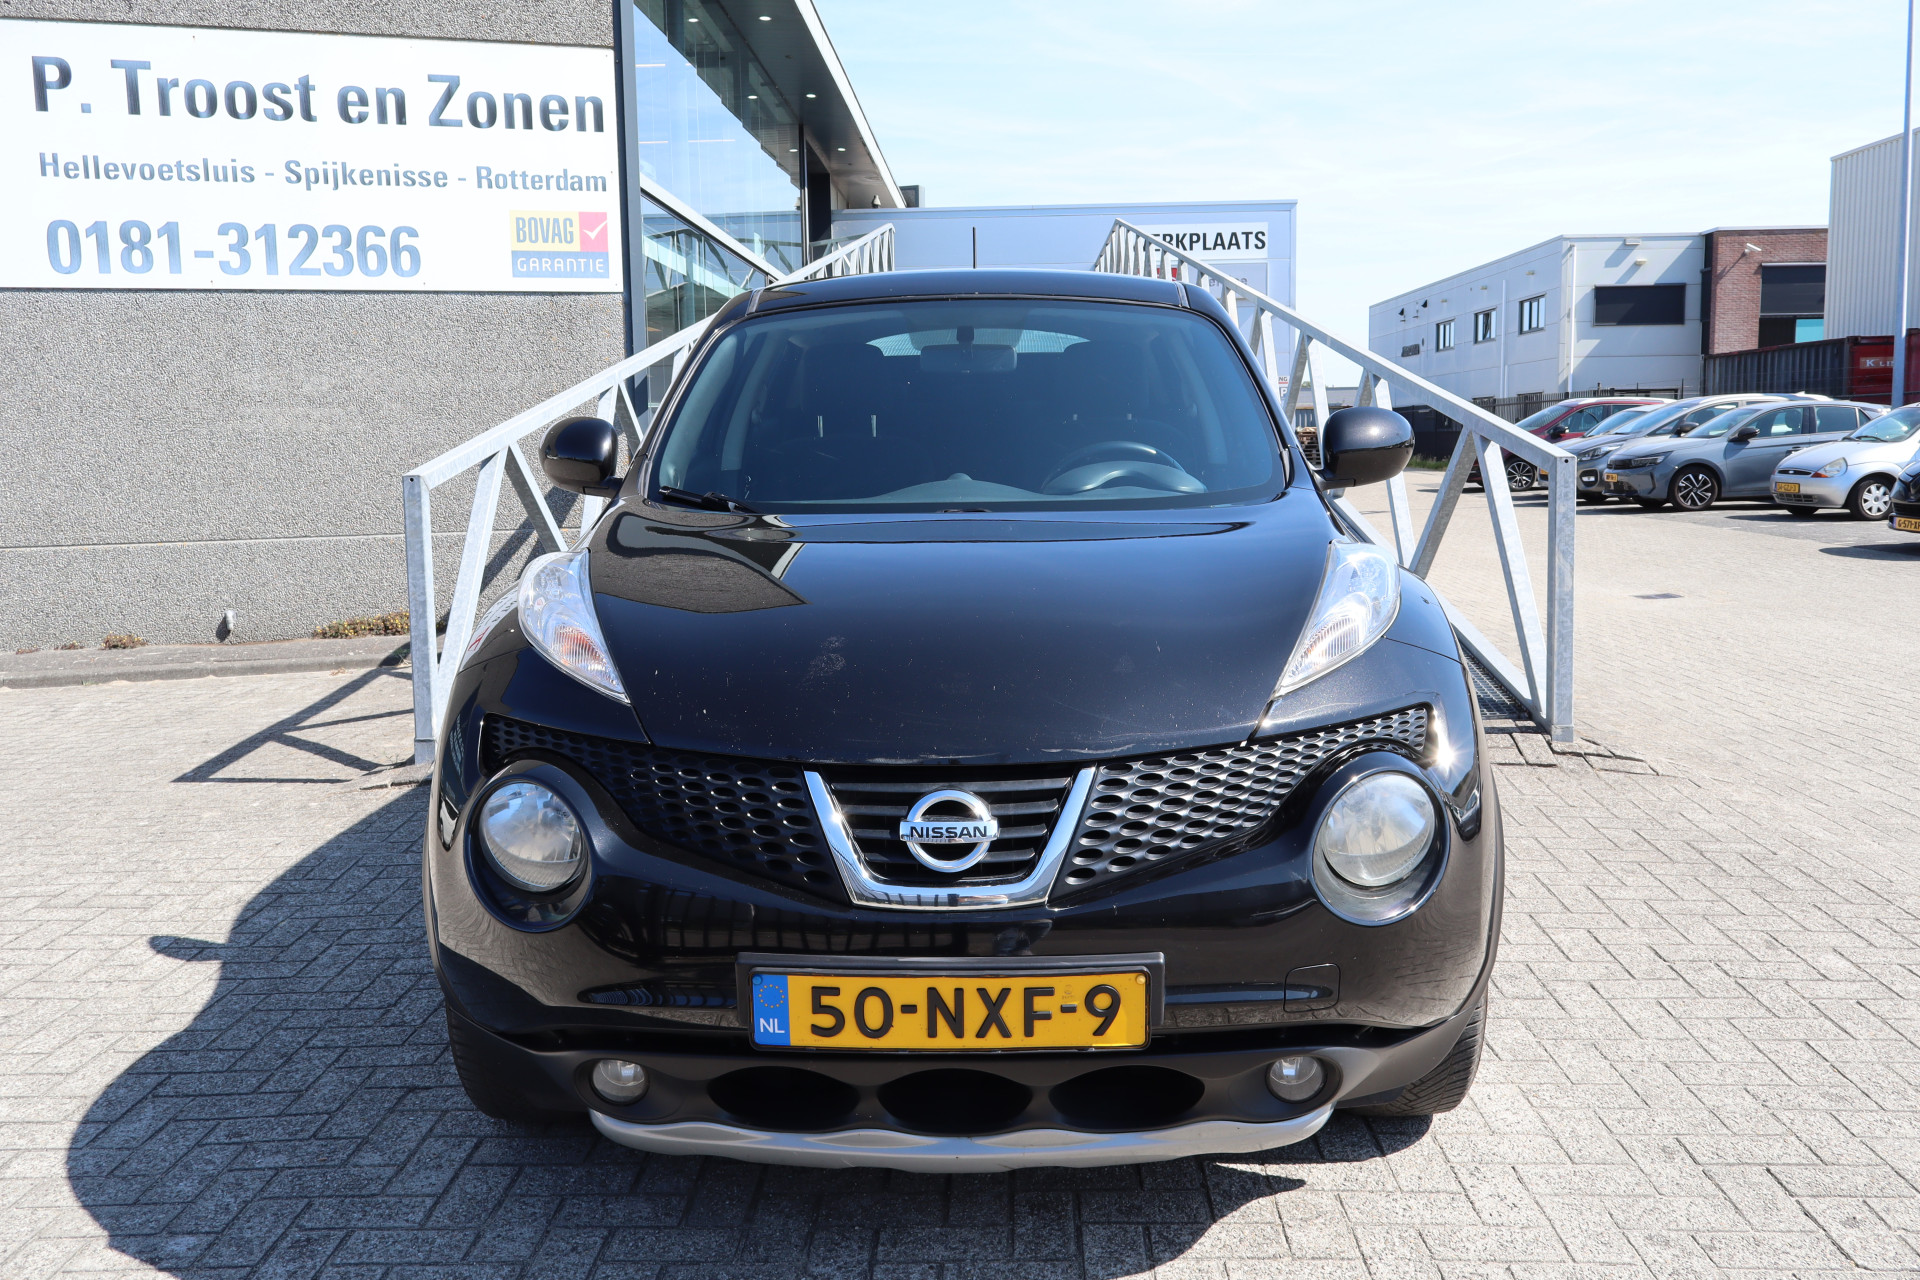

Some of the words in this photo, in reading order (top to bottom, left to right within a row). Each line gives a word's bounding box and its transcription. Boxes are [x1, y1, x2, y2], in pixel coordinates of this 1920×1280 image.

[32, 56, 91, 113] P.
[111, 59, 317, 122] Troost
[337, 85, 406, 125] en
[428, 74, 604, 133] Zonen
[40, 152, 255, 183] Hellevoetsluis
[285, 160, 448, 192] Spijkenisse
[477, 166, 607, 192] Rotterdam
[516, 217, 574, 244] BOVAG
[1143, 231, 1266, 252] RKPLAATS
[47, 219, 422, 277] 0181-312366
[517, 258, 604, 272] GARANTIE
[910, 825, 988, 840] NISSAN
[810, 984, 1121, 1039] 50-NXF-9
[759, 1017, 785, 1034] NL
